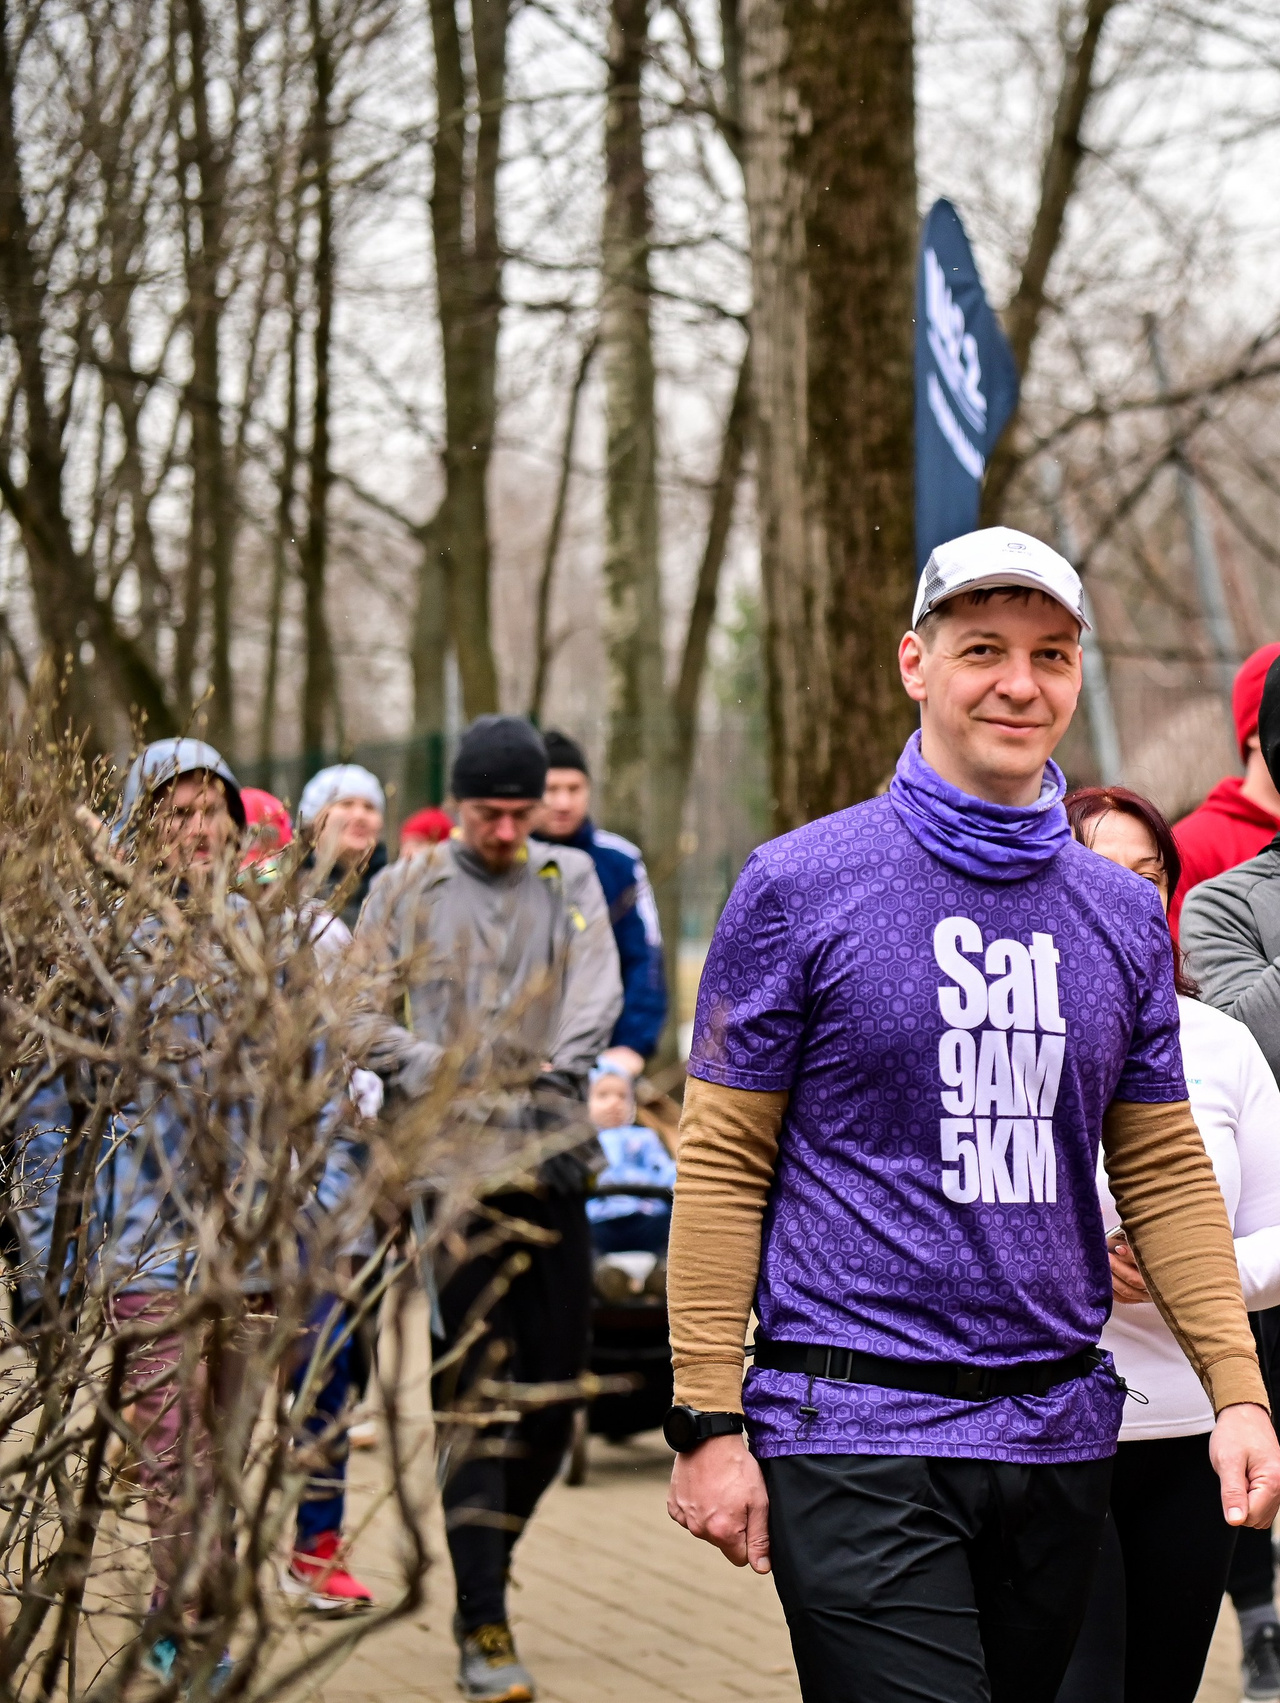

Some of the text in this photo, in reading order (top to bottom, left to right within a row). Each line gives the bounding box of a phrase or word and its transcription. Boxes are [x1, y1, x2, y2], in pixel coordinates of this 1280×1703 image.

[933, 916, 1066, 1034] Sat
[938, 1028, 1066, 1117] 9AM
[940, 1117, 1057, 1204] 5KM
